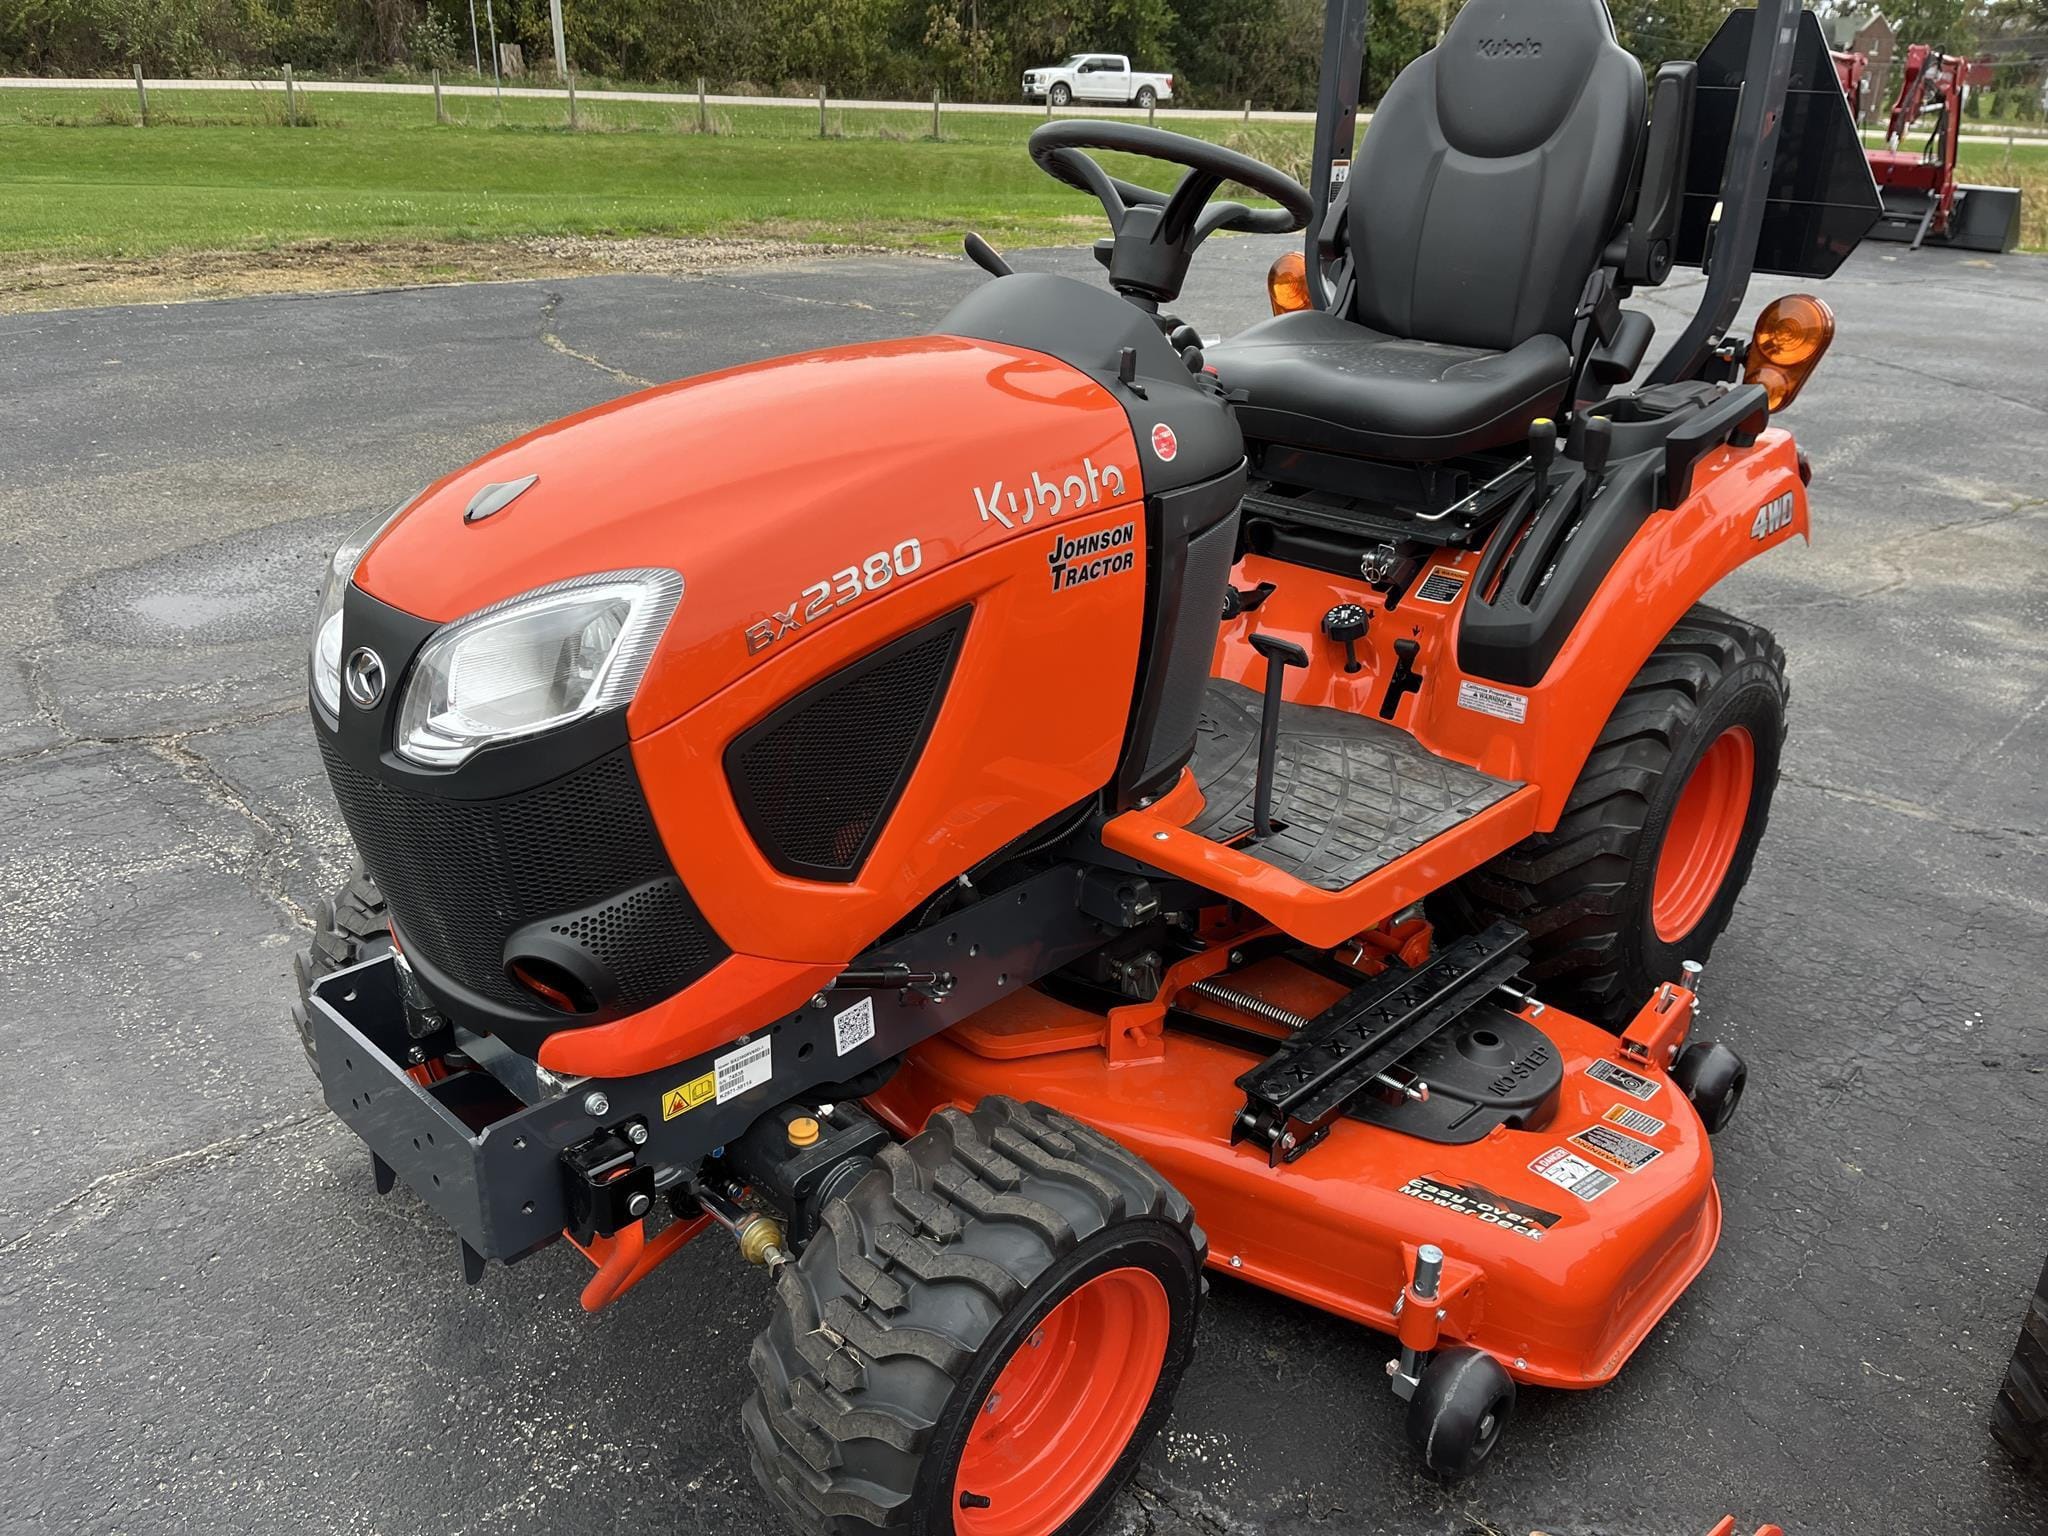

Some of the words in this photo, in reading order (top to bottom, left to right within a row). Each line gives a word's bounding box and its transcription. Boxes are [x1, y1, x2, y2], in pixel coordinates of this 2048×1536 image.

[1478, 38, 1542, 57] Kubota
[973, 457, 1126, 529] Kubota
[1750, 490, 1794, 541] 4WD
[1048, 524, 1134, 564] JOHNSON
[1051, 551, 1134, 591] TRACTOR
[744, 537, 922, 657] BX2380
[1488, 1076, 1518, 1097] NO
[1511, 1045, 1549, 1079] STEP
[1398, 1185, 1478, 1215] Mower
[1478, 1212, 1543, 1241] Deck
[1407, 1178, 1535, 1225] Easy-over
